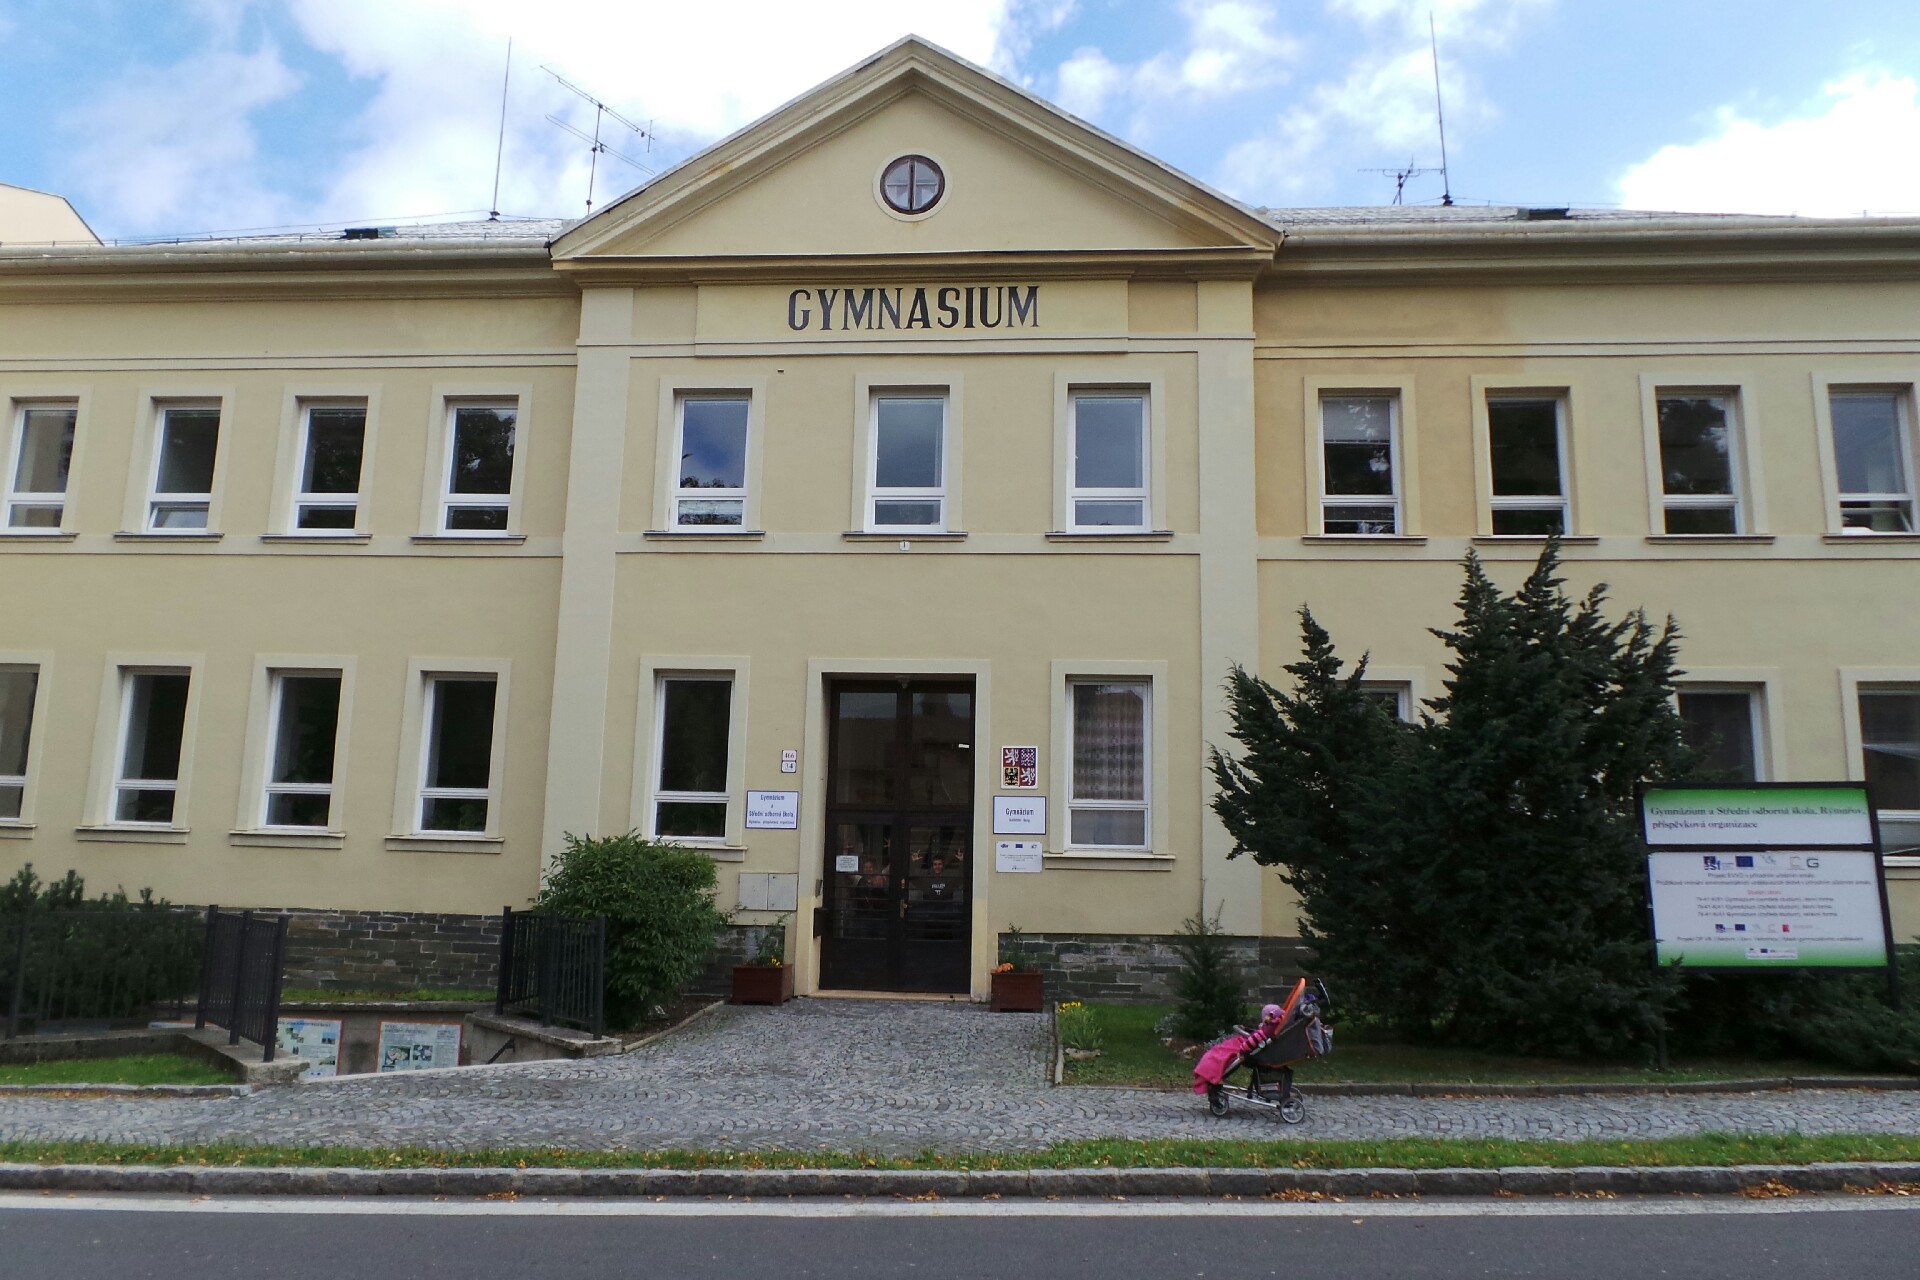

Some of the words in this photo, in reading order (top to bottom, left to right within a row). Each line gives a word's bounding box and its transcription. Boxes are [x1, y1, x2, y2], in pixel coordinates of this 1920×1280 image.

[788, 285, 1039, 331] GYMNASIUM
[1005, 807, 1035, 816] Gymnázium
[1650, 806, 1706, 816] Gymnázium
[1716, 806, 1750, 815] Střední
[1752, 806, 1789, 815] odborná
[1652, 819, 1706, 829] příspěvková
[1707, 820, 1758, 829] organizace
